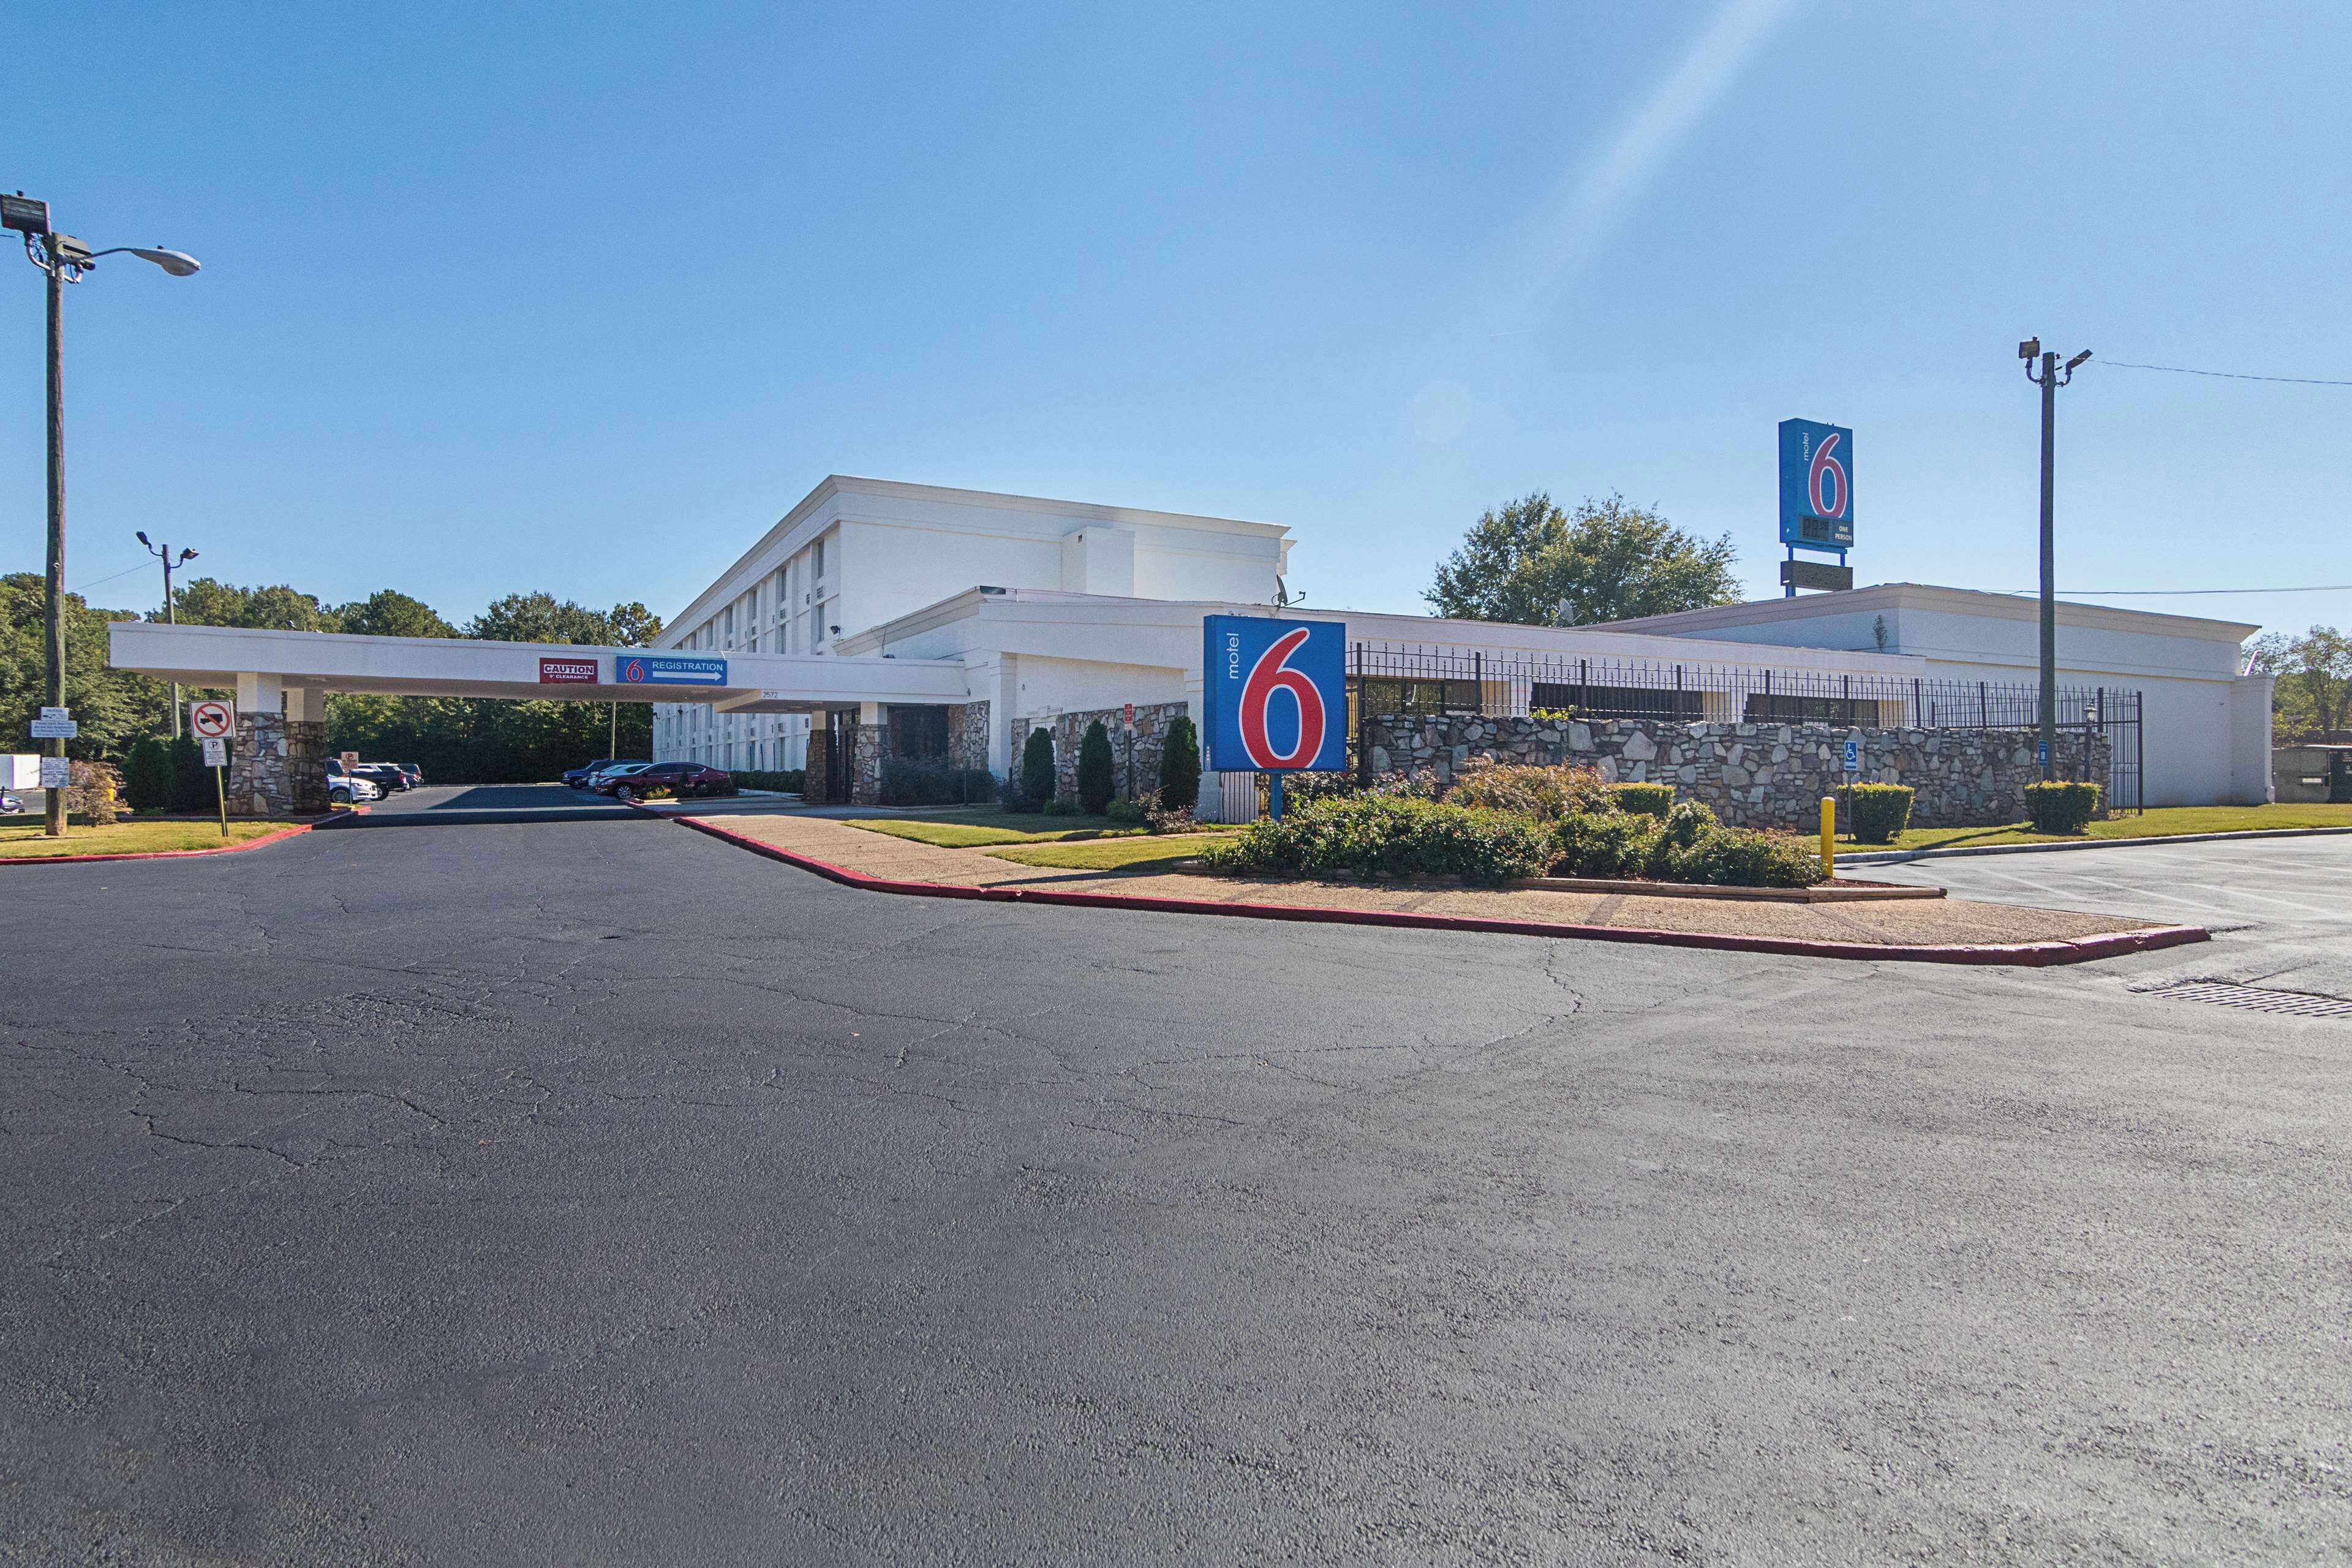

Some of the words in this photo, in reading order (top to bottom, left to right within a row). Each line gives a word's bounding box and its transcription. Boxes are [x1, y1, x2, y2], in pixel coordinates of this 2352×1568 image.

[1809, 433, 1847, 518] 6
[626, 658, 644, 682] 6
[652, 662, 723, 671] REGISTRATION
[1227, 633, 1239, 679] motel
[1238, 627, 1326, 768] 6
